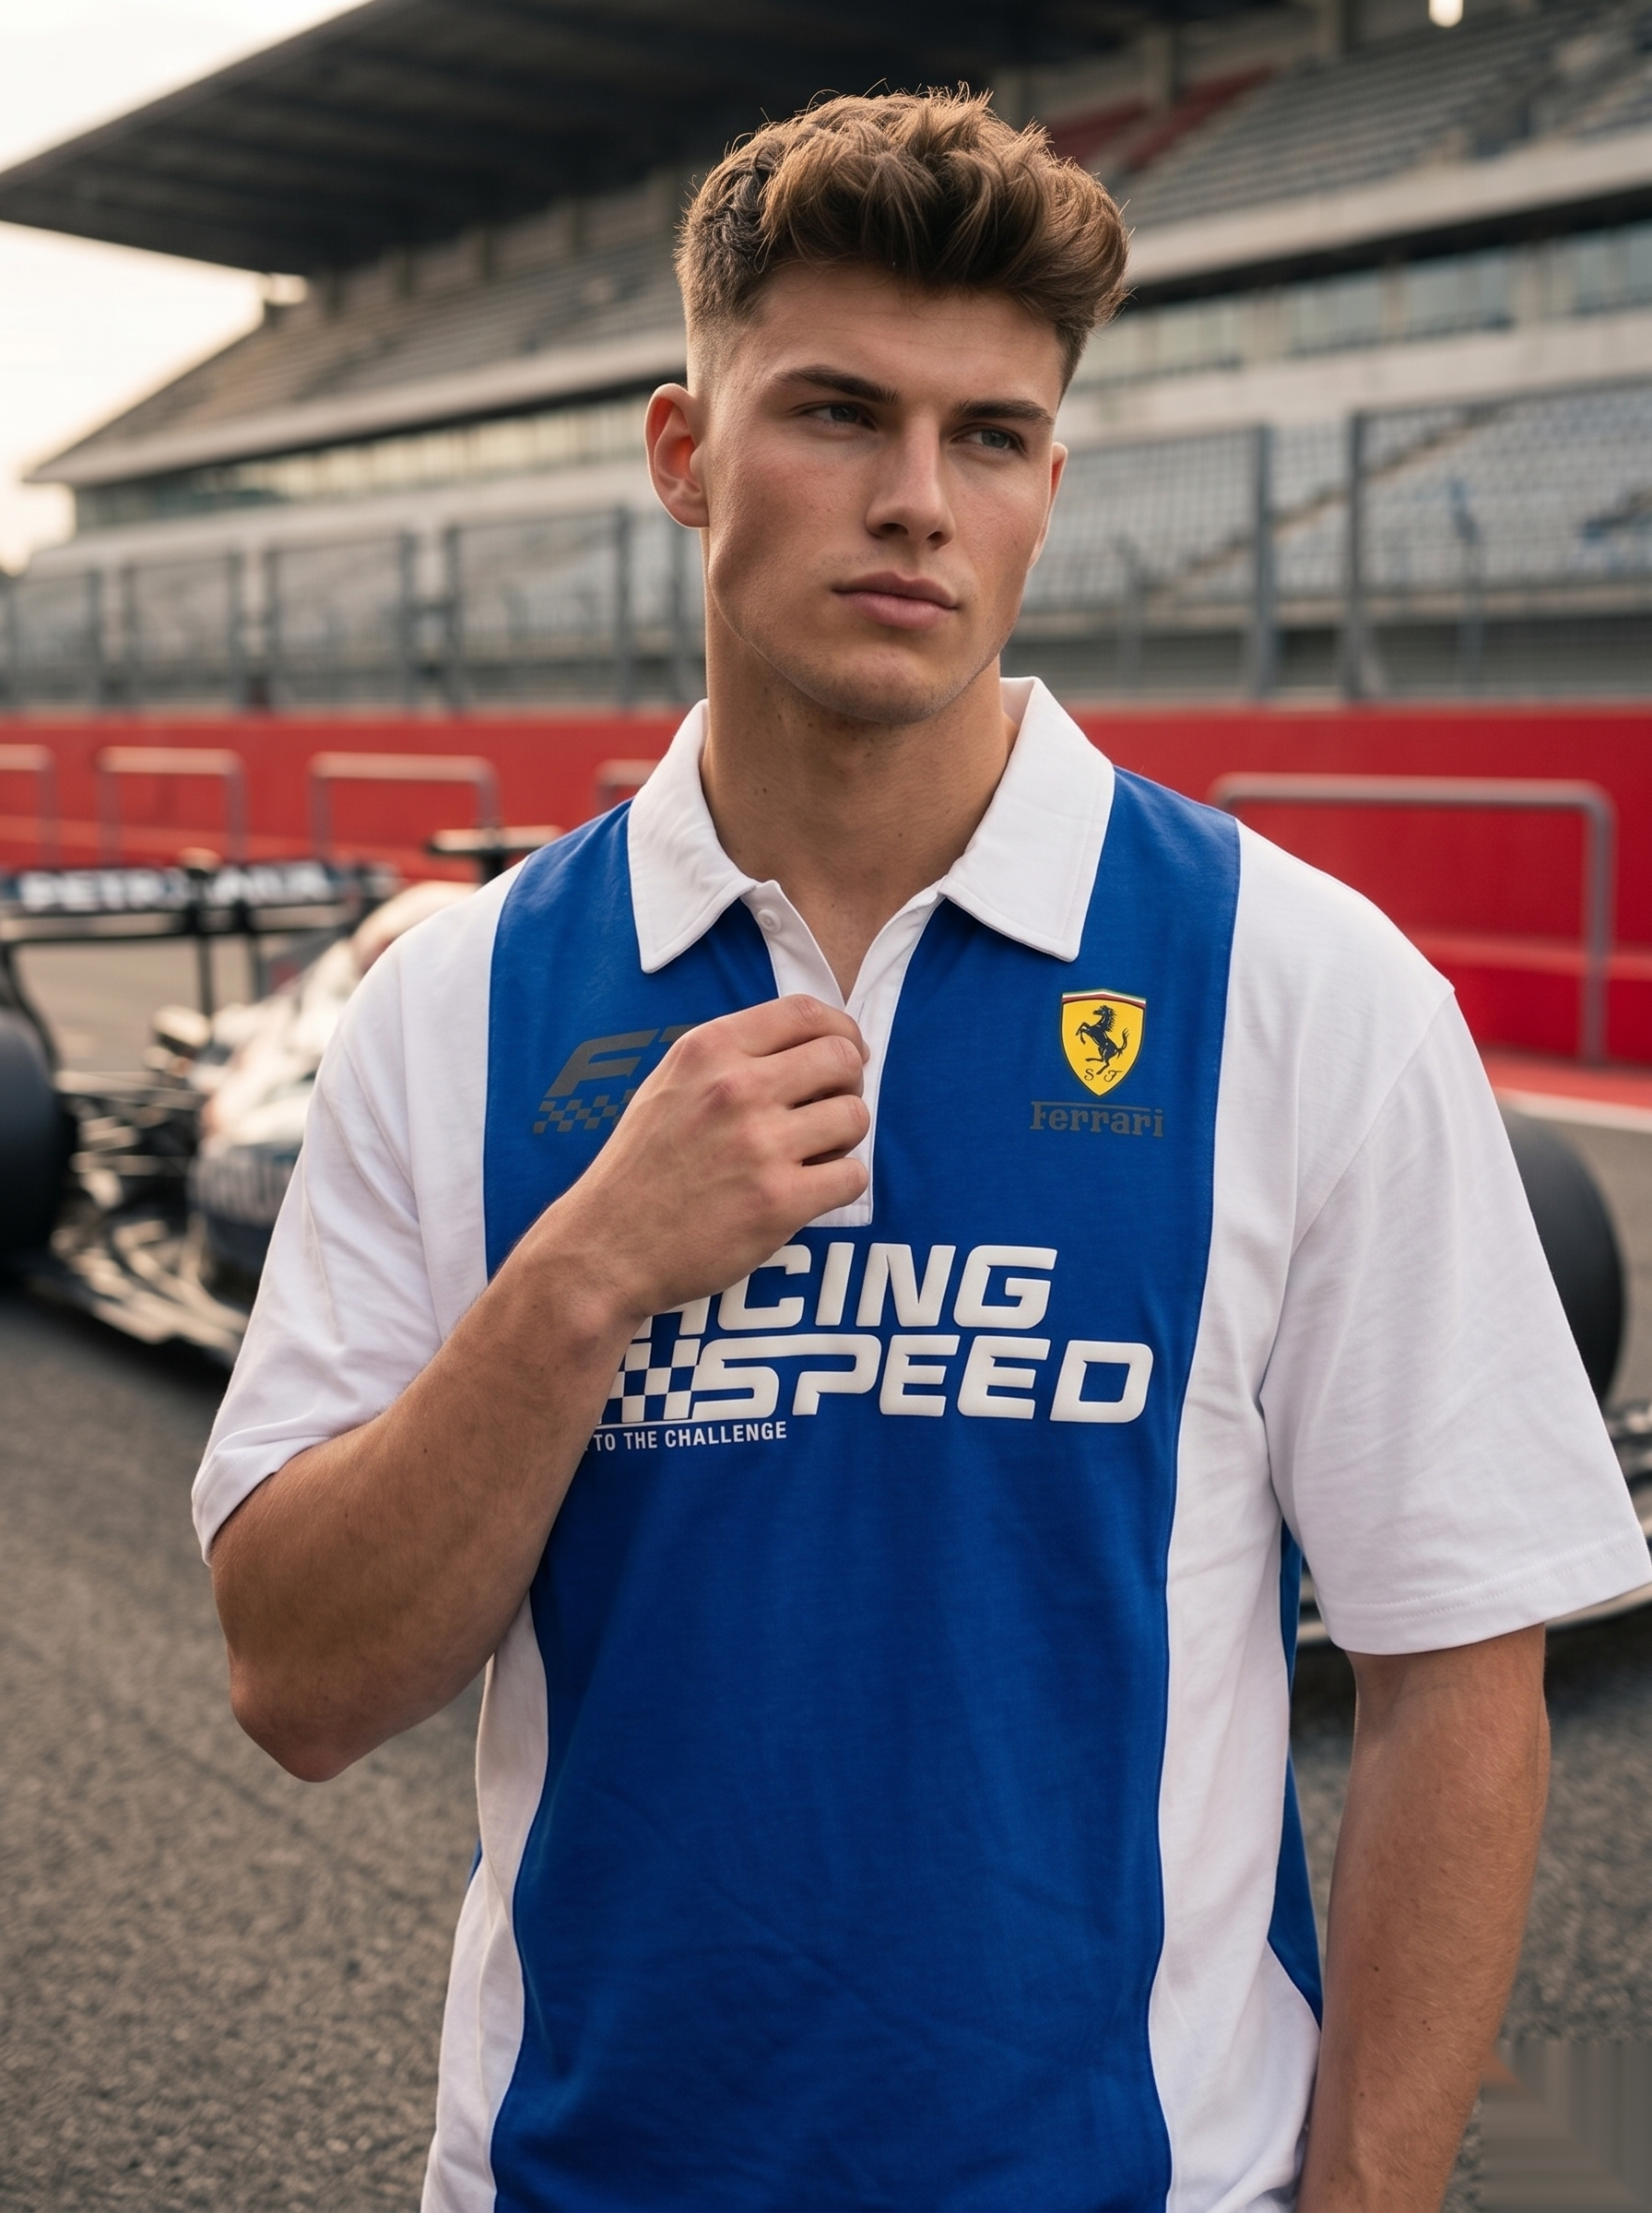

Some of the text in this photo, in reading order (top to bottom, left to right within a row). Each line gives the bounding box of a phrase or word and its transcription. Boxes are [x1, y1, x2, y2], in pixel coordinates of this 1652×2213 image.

[544, 1024, 698, 1098] F
[1084, 1068, 1094, 1081] S
[1030, 1101, 1163, 1137] Ferrari
[691, 1333, 1153, 1422] SPEED
[593, 1422, 786, 1451] TO THE CHALLENGE
